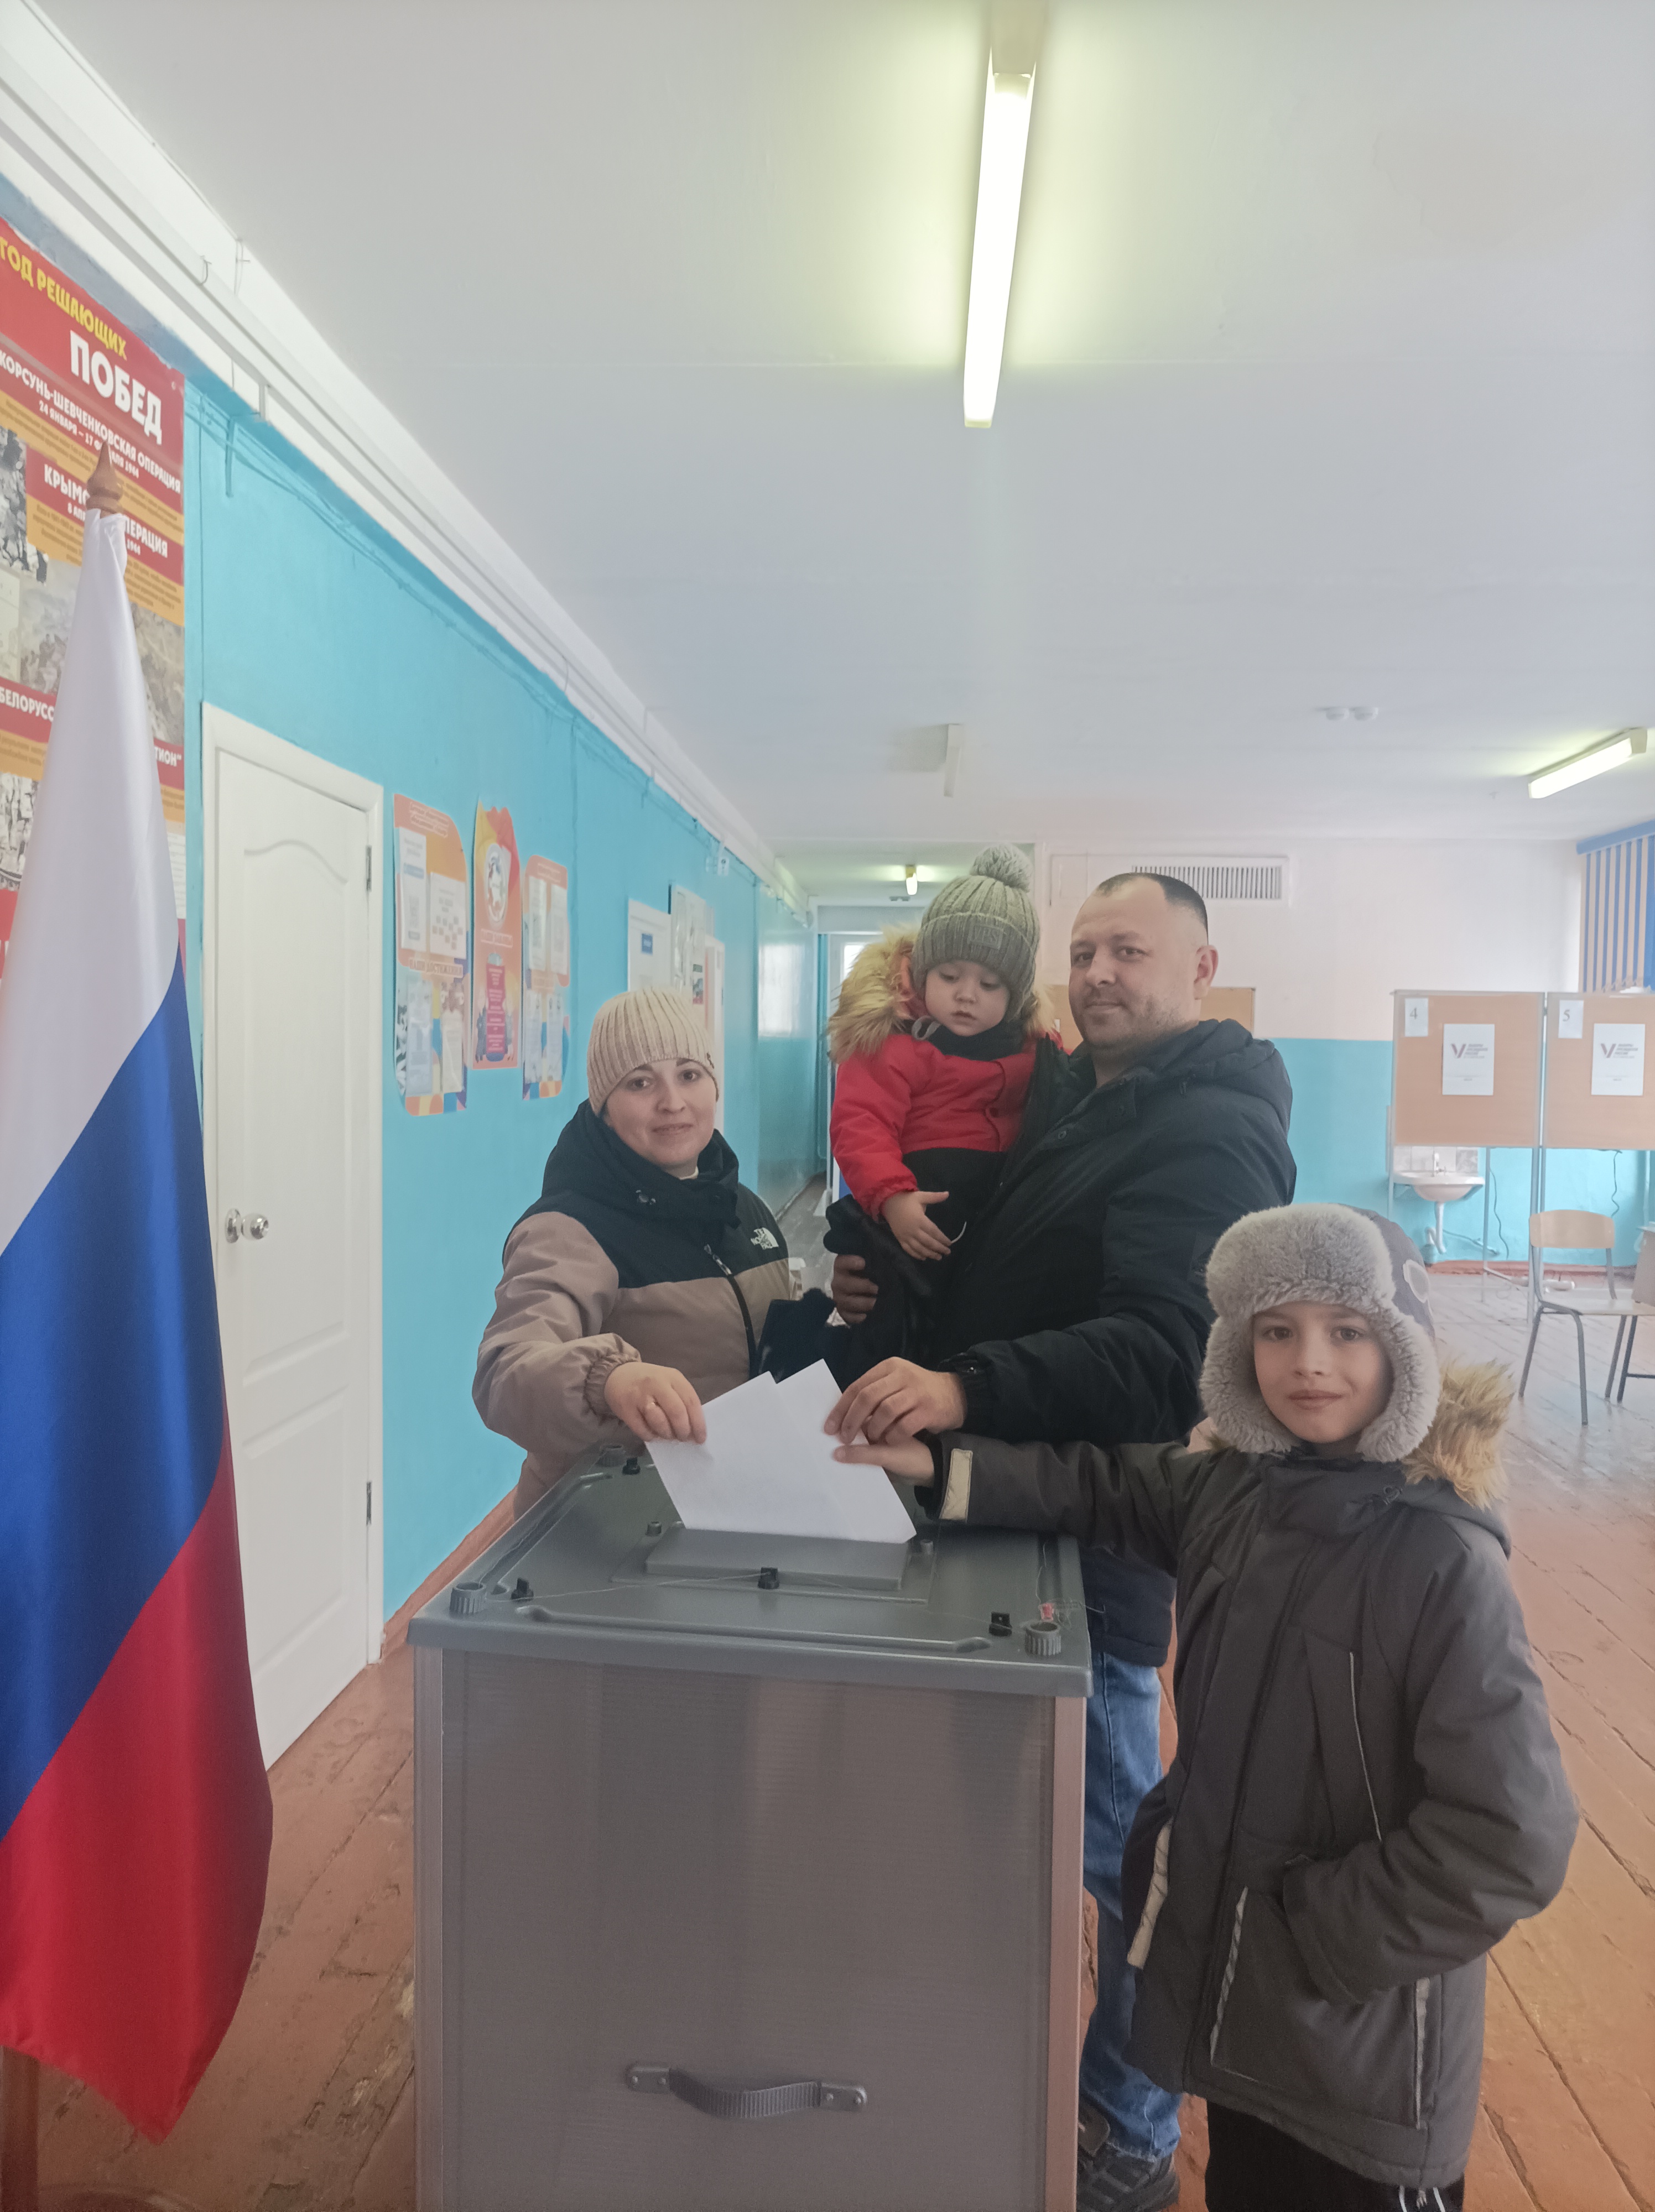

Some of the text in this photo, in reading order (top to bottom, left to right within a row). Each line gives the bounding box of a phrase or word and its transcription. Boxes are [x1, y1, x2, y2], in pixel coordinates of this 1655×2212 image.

[0, 236, 127, 361] ГОД РЕШАЮЩИХ
[0, 349, 136, 462] КОРСУНЬ-ШЕВЧЕНКОВСКАЯ
[138, 451, 181, 493] ОПЕРАЦИЯ
[70, 330, 162, 445] ПОБЕД
[39, 399, 49, 416] 24
[49, 408, 77, 436] ЯНВАРЯ
[85, 432, 93, 446] 17
[125, 460, 139, 479] 1944
[44, 463, 90, 505] КРЫМС
[124, 517, 168, 558] ПЕРАЦИЯ
[0, 686, 54, 722] БЕЛОРУСС
[1409, 1007, 1418, 1020] 4
[1562, 1009, 1570, 1022] 5
